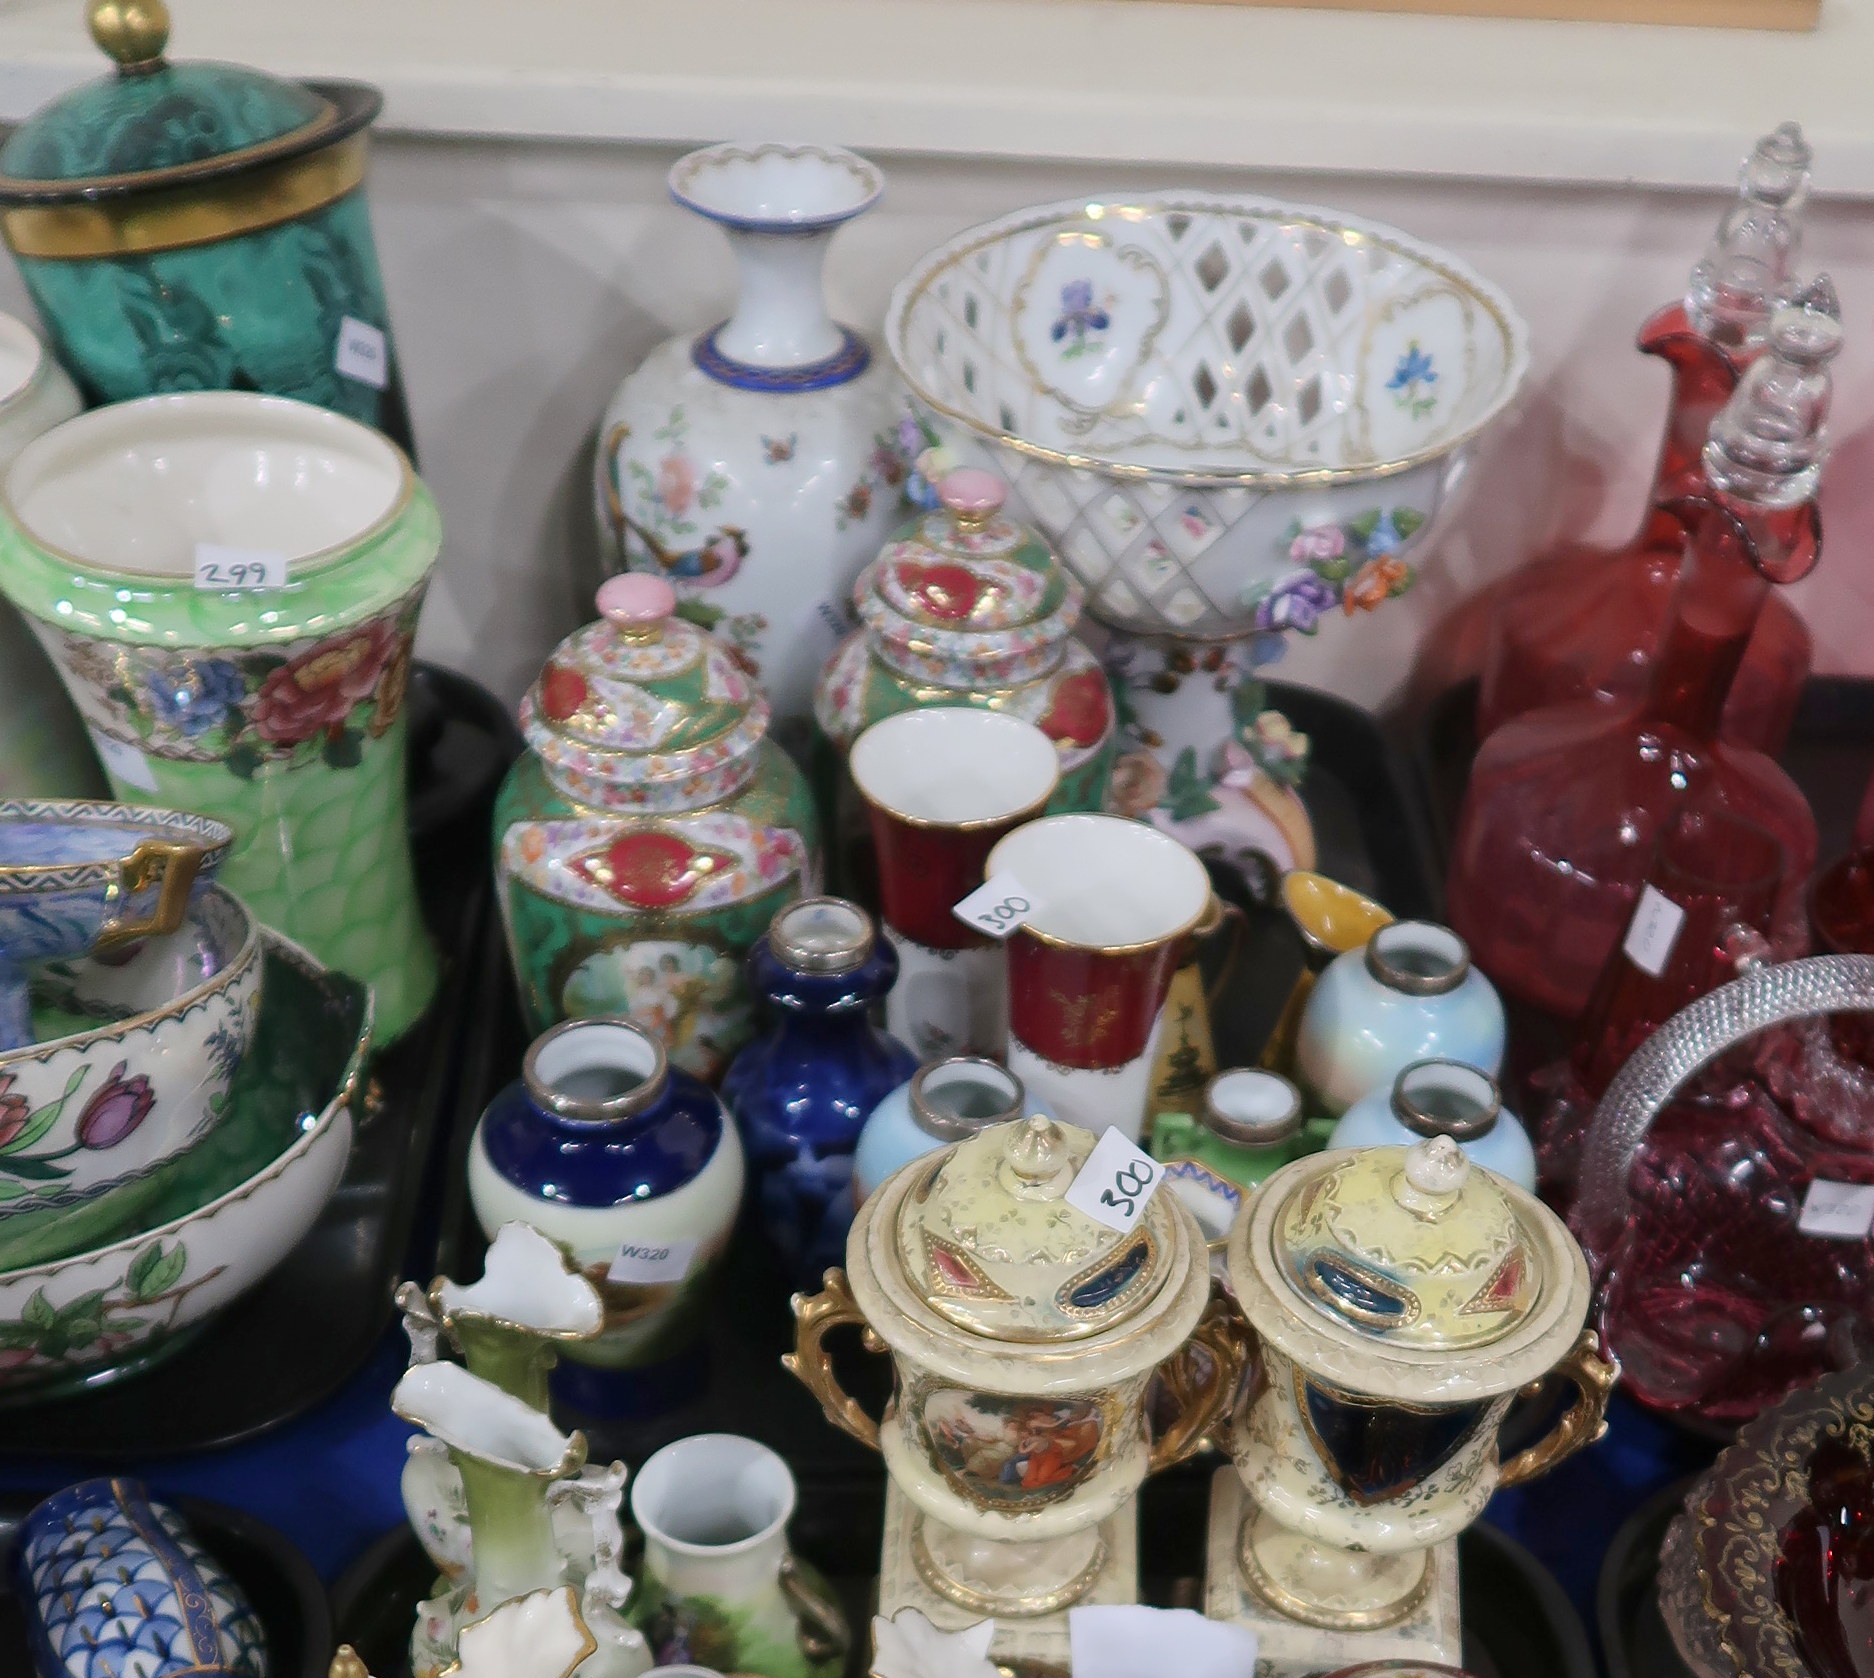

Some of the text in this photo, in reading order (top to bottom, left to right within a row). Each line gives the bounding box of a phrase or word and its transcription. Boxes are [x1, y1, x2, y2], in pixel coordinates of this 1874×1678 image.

[199, 562, 266, 585] 299
[977, 896, 1031, 930] 300
[1100, 1159, 1154, 1217] 300
[621, 1244, 670, 1261] W320
